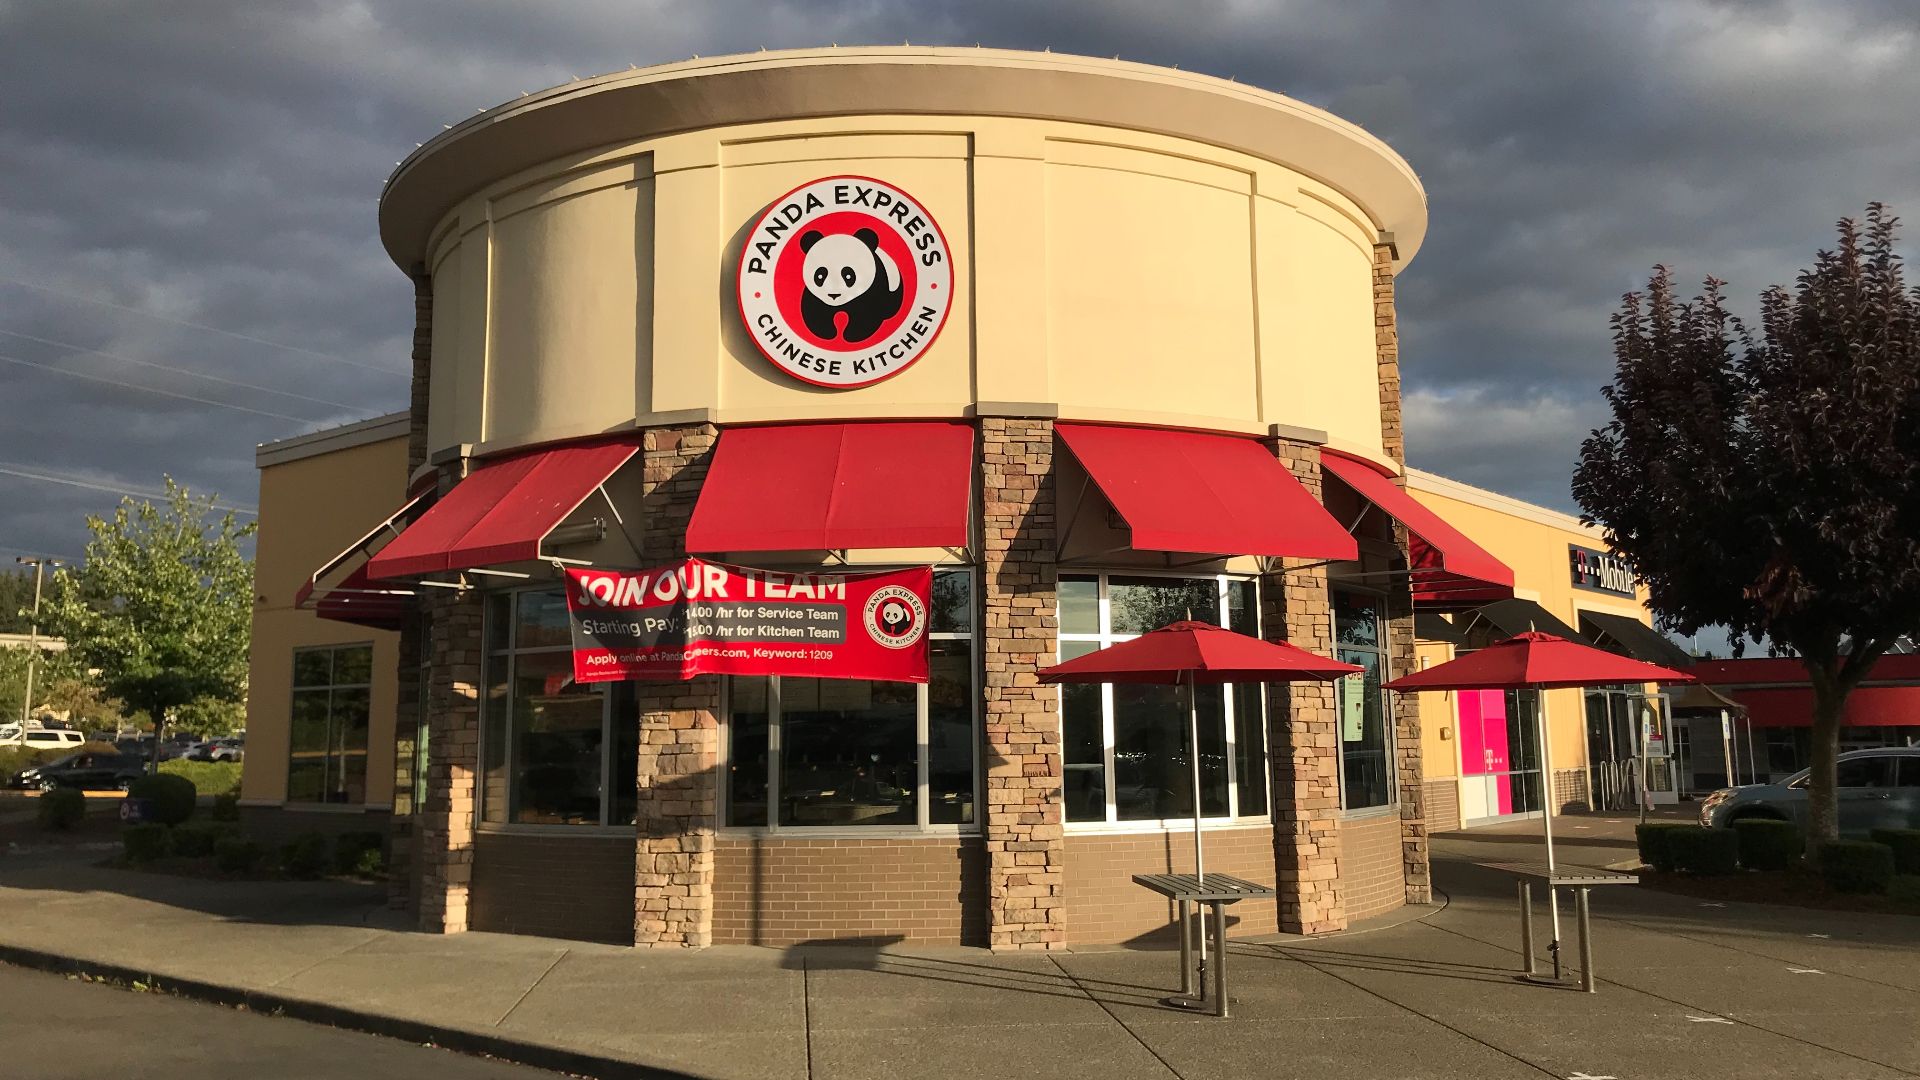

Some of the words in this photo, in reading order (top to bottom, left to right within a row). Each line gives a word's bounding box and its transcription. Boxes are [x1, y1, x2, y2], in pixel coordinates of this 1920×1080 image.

[748, 192, 825, 275] PANDA
[834, 185, 942, 267] EXPRESS
[757, 313, 842, 376] CHINESE
[853, 306, 938, 375] KITCHEN
[577, 575, 650, 608] JOIN
[653, 564, 729, 602] OUR
[740, 569, 847, 600] TEAM
[716, 606, 734, 619] /hr
[737, 606, 755, 619] for
[757, 606, 804, 620] Service
[806, 608, 839, 621] Team
[868, 590, 891, 613] PANDA
[892, 589, 923, 616] EXPRESS
[583, 617, 641, 638] Starting
[644, 616, 680, 635] Pay:
[716, 624, 734, 637] /hr
[737, 625, 755, 637] for
[757, 625, 804, 638] Kitchen
[807, 627, 840, 640] Team
[869, 623, 894, 645] CHINESE
[895, 626, 921, 645] KITCHEN
[586, 652, 618, 666] Apply
[619, 652, 647, 664] online
[650, 652, 660, 663] at
[753, 647, 808, 660] Keyword:
[809, 649, 833, 660] 1209
